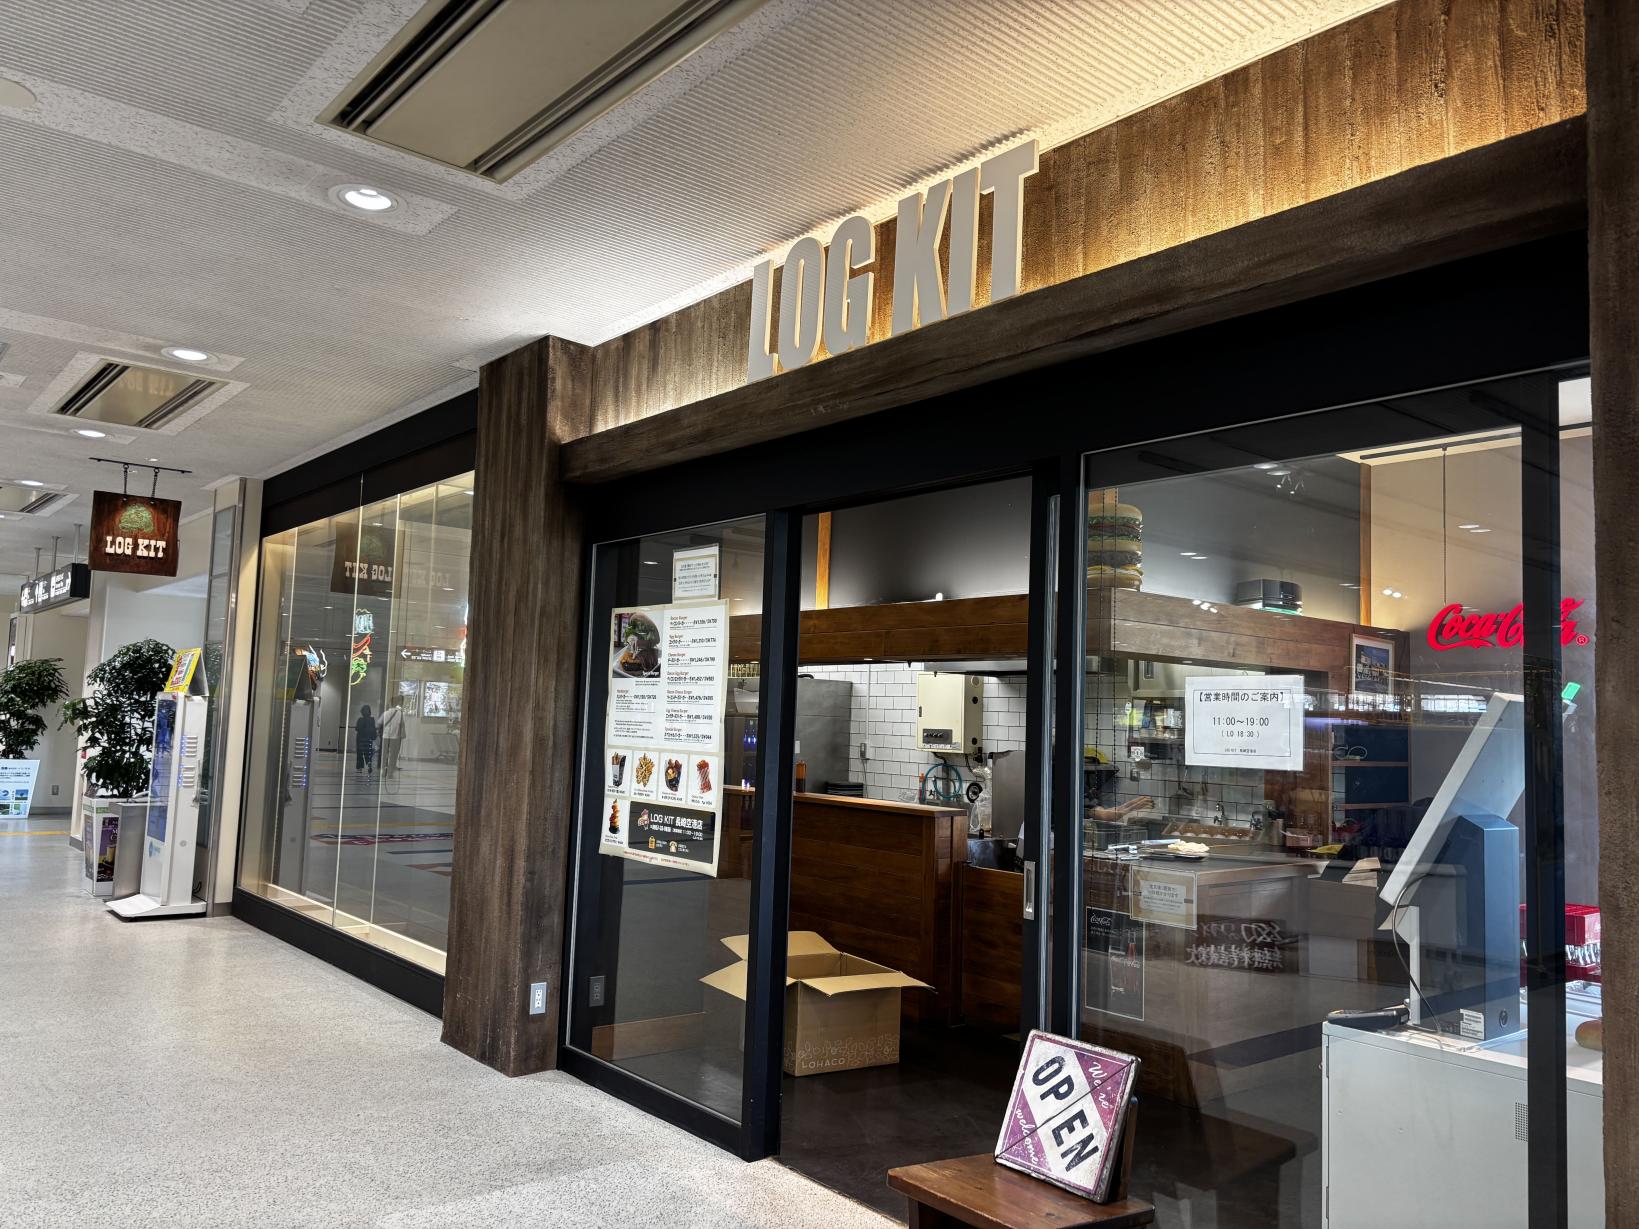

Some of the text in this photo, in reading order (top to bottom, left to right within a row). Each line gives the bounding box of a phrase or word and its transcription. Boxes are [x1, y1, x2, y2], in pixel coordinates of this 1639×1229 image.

[748, 138, 1039, 385] LOG KIT
[105, 535, 166, 558] LOG KIT
[1427, 598, 1585, 651] Coca-Coa
[1199, 691, 1284, 703] 【営業時間のご案内】
[650, 813, 663, 824] LOG
[664, 815, 674, 825] KIT
[801, 1057, 846, 1069] LOHACO
[1032, 1055, 1099, 1173] OPEN
[1015, 1108, 1040, 1165] welcome
